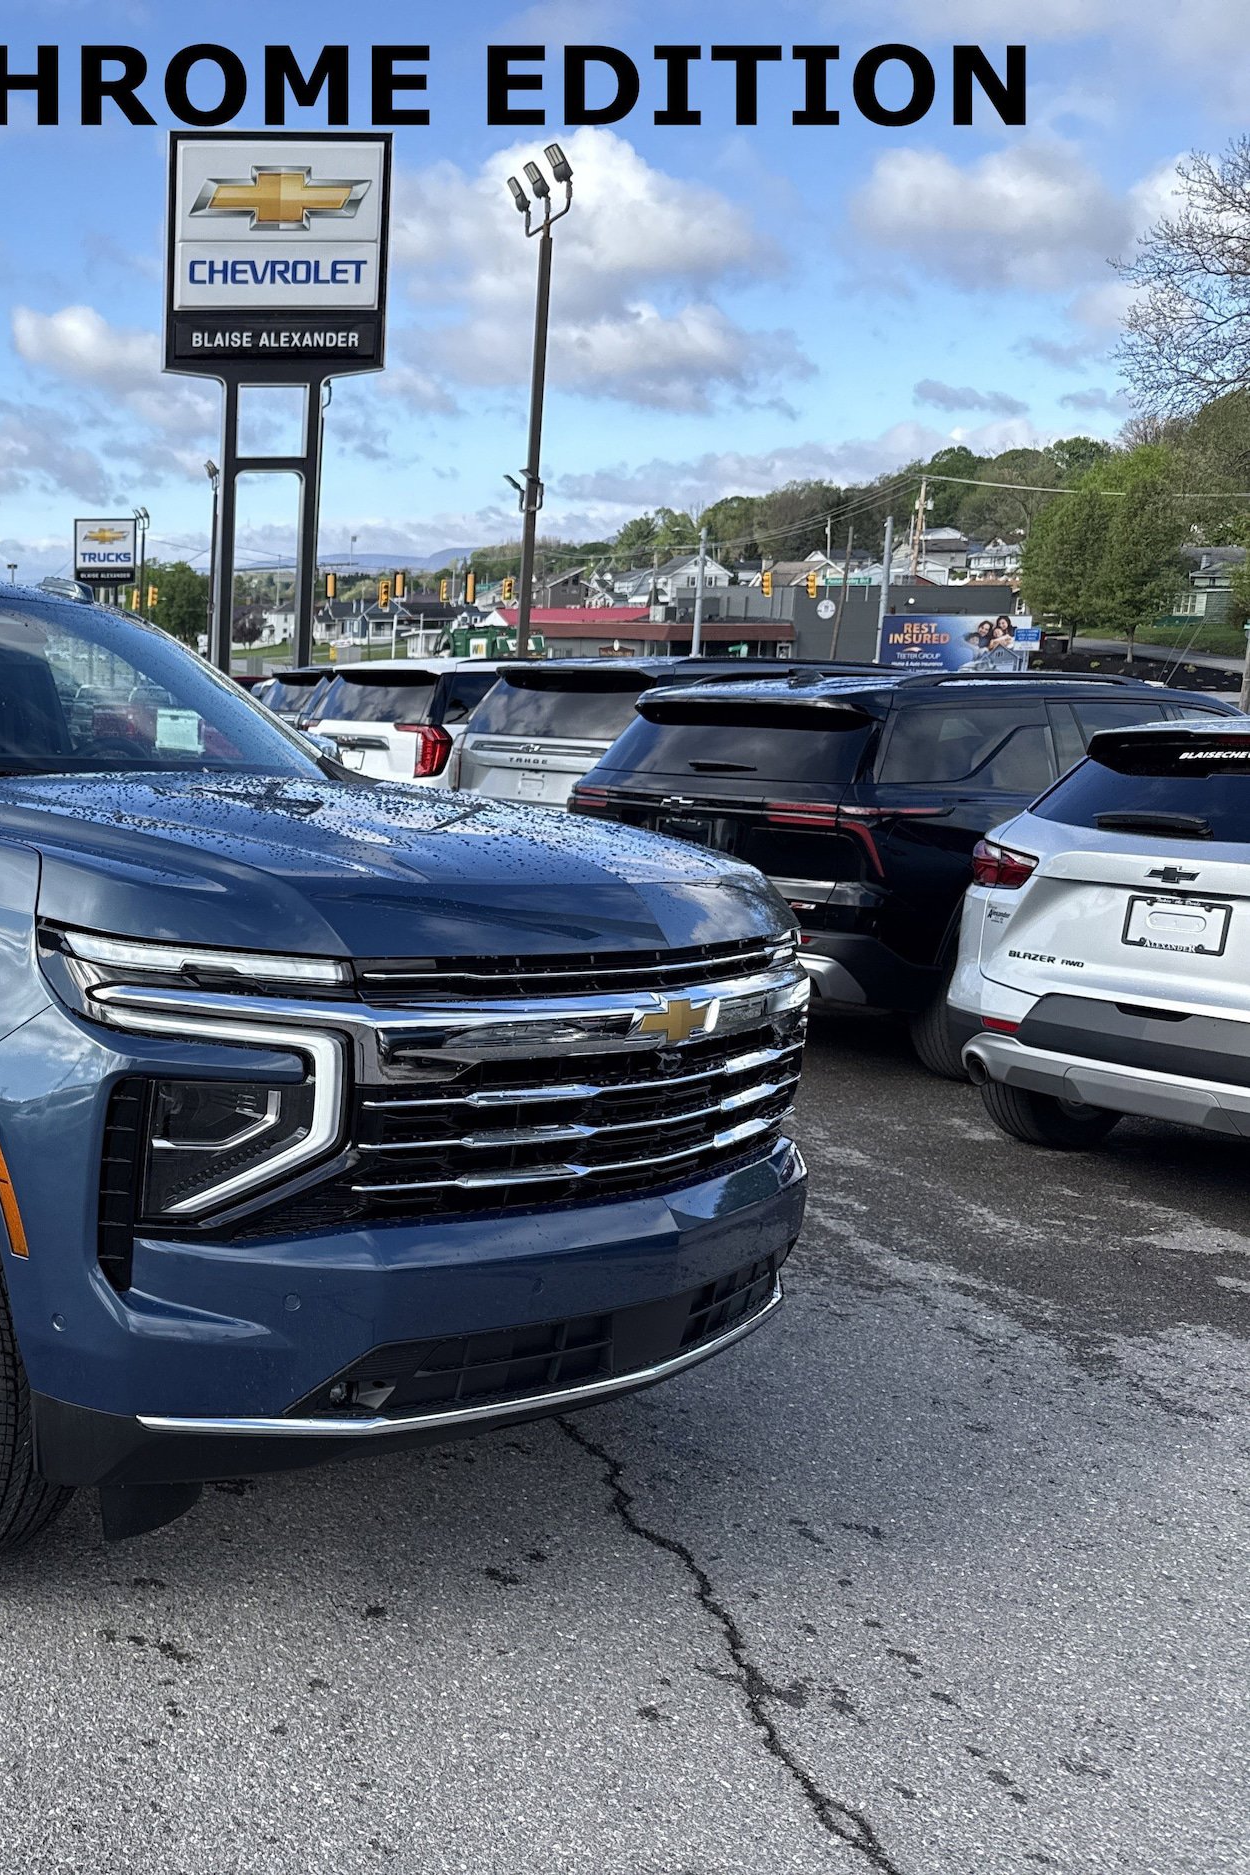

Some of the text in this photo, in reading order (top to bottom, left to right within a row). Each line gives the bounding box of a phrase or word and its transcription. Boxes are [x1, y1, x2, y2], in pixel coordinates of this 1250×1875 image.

[189, 260, 368, 285] CHEVROLET
[191, 332, 359, 348] BLAISE ALEXANDER
[80, 552, 131, 563] TRUCKS
[903, 623, 938, 634] REST
[889, 633, 950, 645] INSURED
[471, 642, 484, 654] WM
[509, 757, 548, 765] TAHOE
[1179, 751, 1250, 760] BLAISECHE
[1143, 939, 1196, 953] ALEXANDER
[1008, 950, 1085, 968] BLAZER AWD
